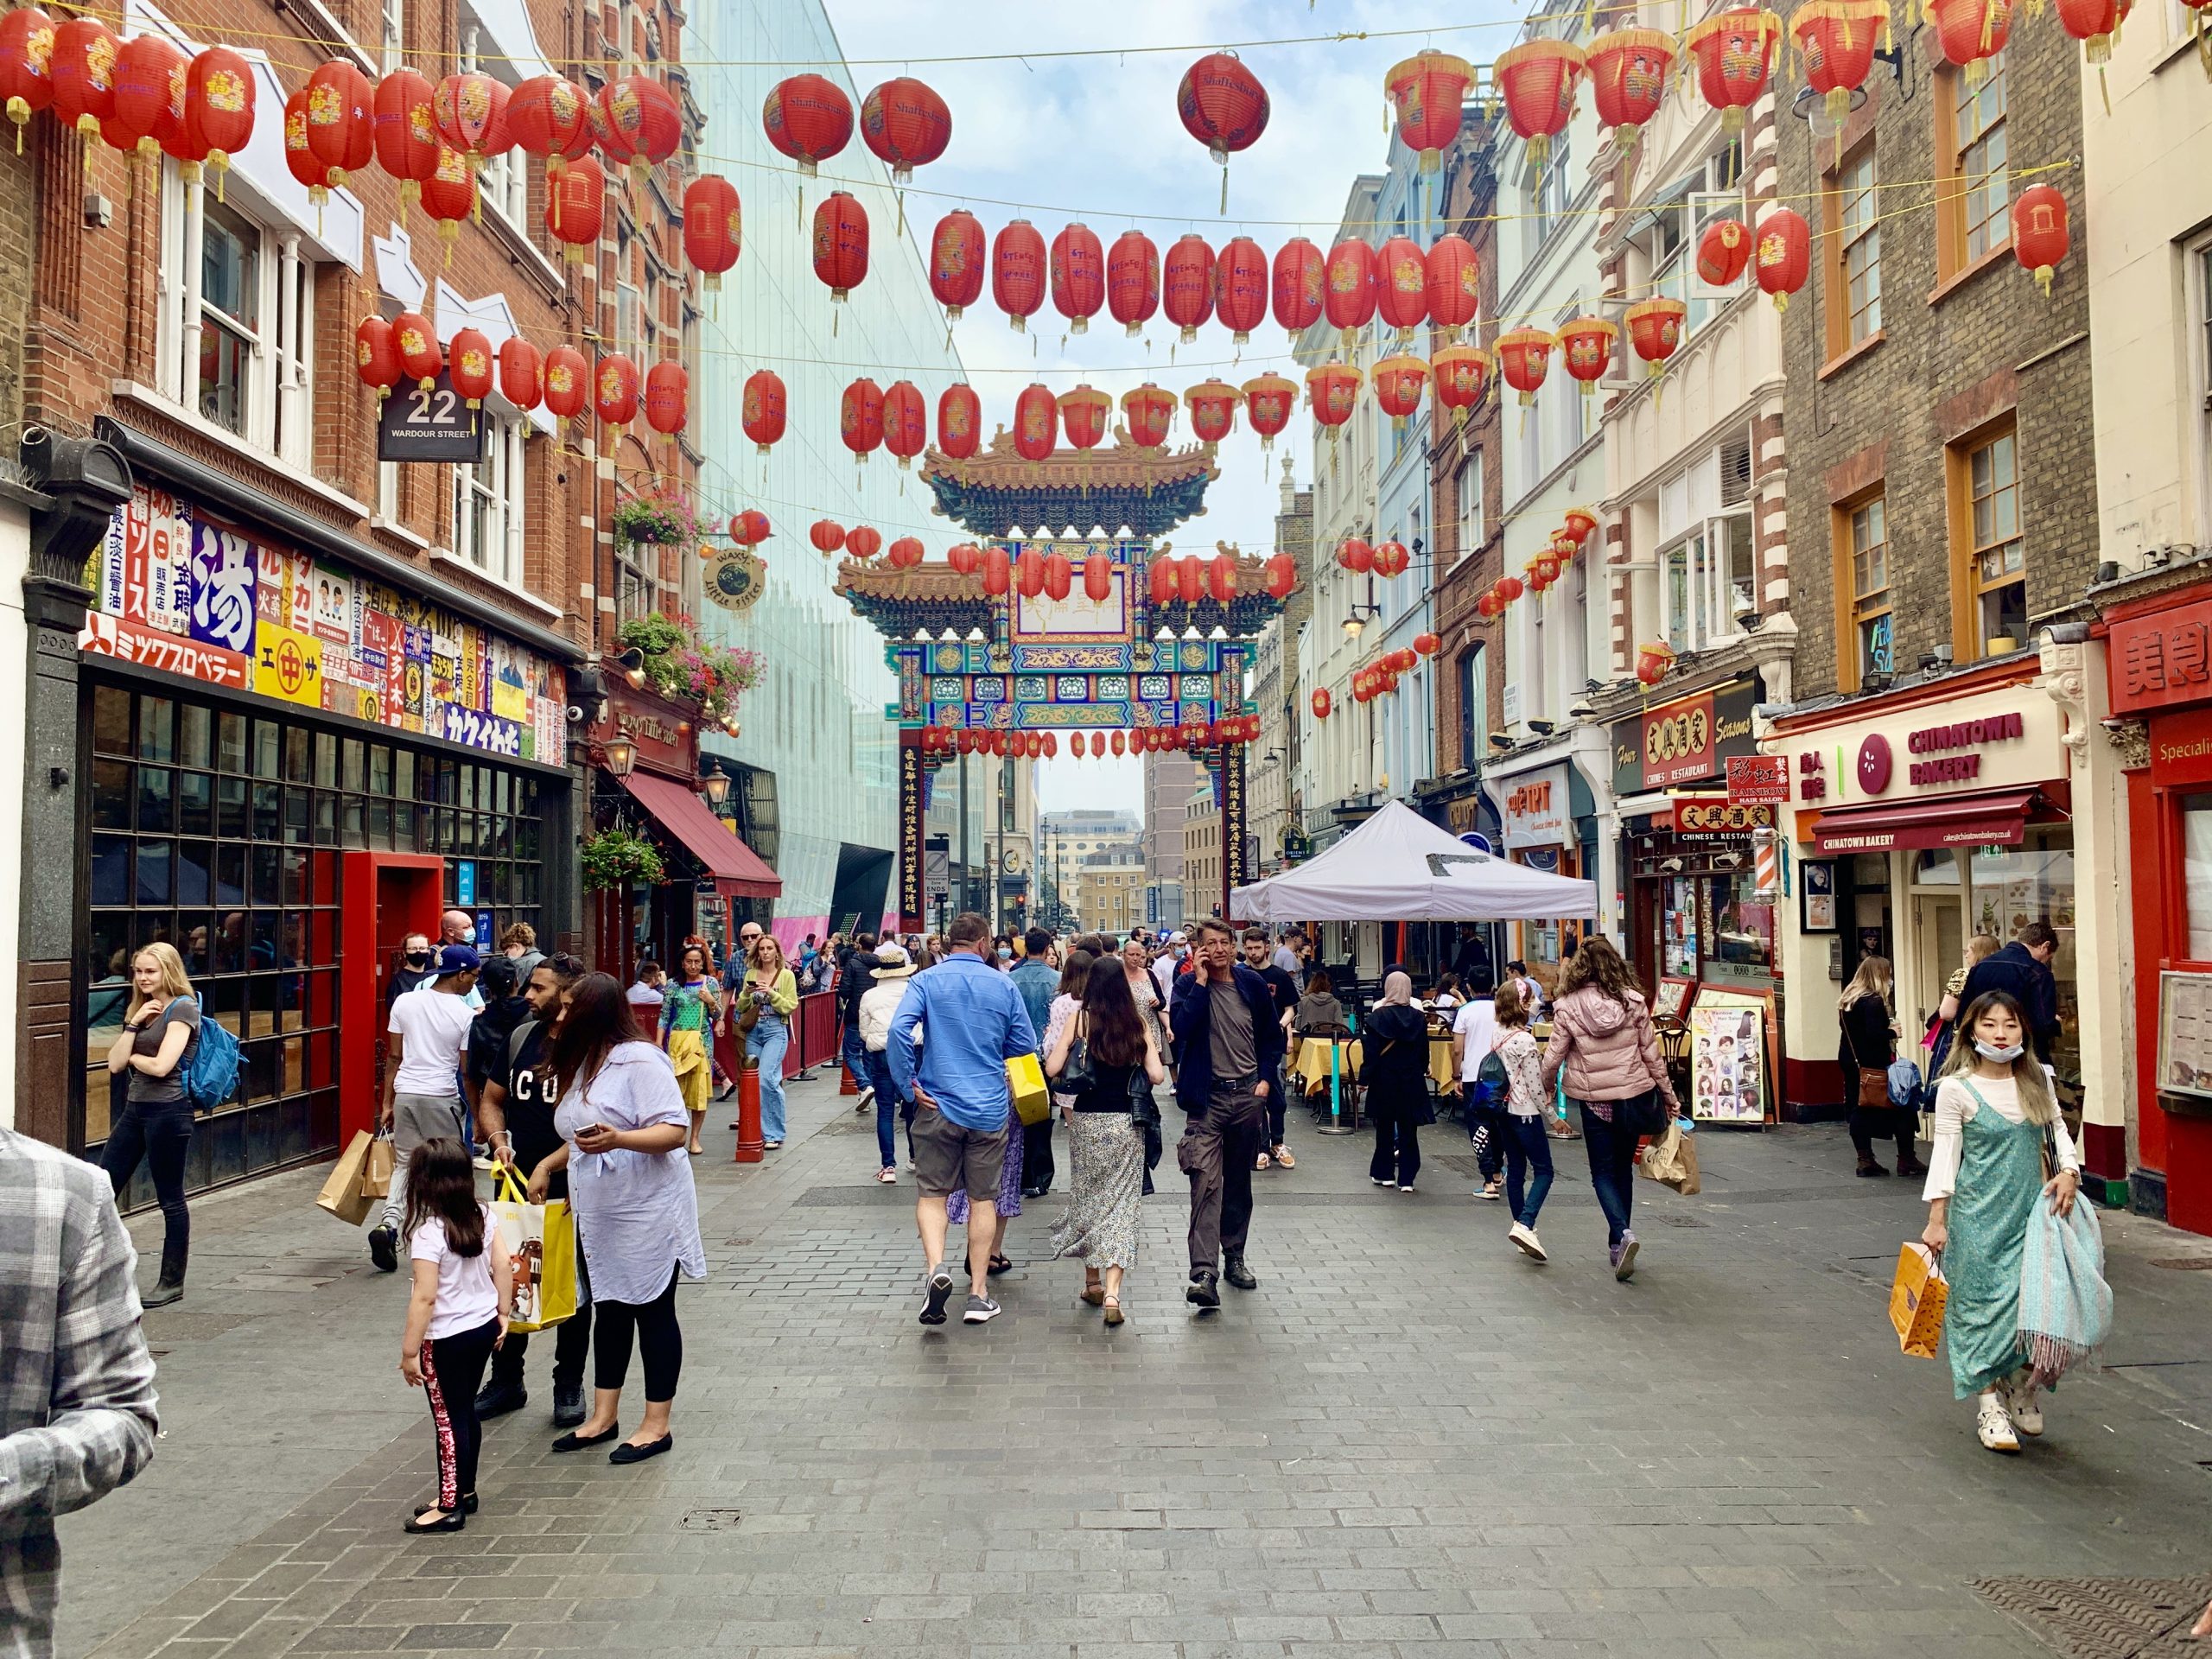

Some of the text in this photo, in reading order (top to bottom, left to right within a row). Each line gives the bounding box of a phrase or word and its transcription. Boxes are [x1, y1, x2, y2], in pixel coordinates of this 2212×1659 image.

[406, 390, 456, 424] 22
[391, 429, 471, 439] WARDOUR STREET
[1617, 715, 1752, 772] Four Seasons
[1908, 711, 2024, 754] CHINATOWN
[1646, 762, 1709, 785] CHINES RESTAURANT
[1729, 758, 1778, 785] 彩虹
[1909, 753, 1981, 786] BAKERY
[1730, 786, 1789, 798] RAINBOW
[1684, 805, 1768, 829] 文興酒家
[1720, 832, 1751, 841] RESTAU
[1823, 834, 1895, 850] CHINATOWN BAKERY
[1943, 830, 2012, 842] cakes@chinatownbakery.co.uk
